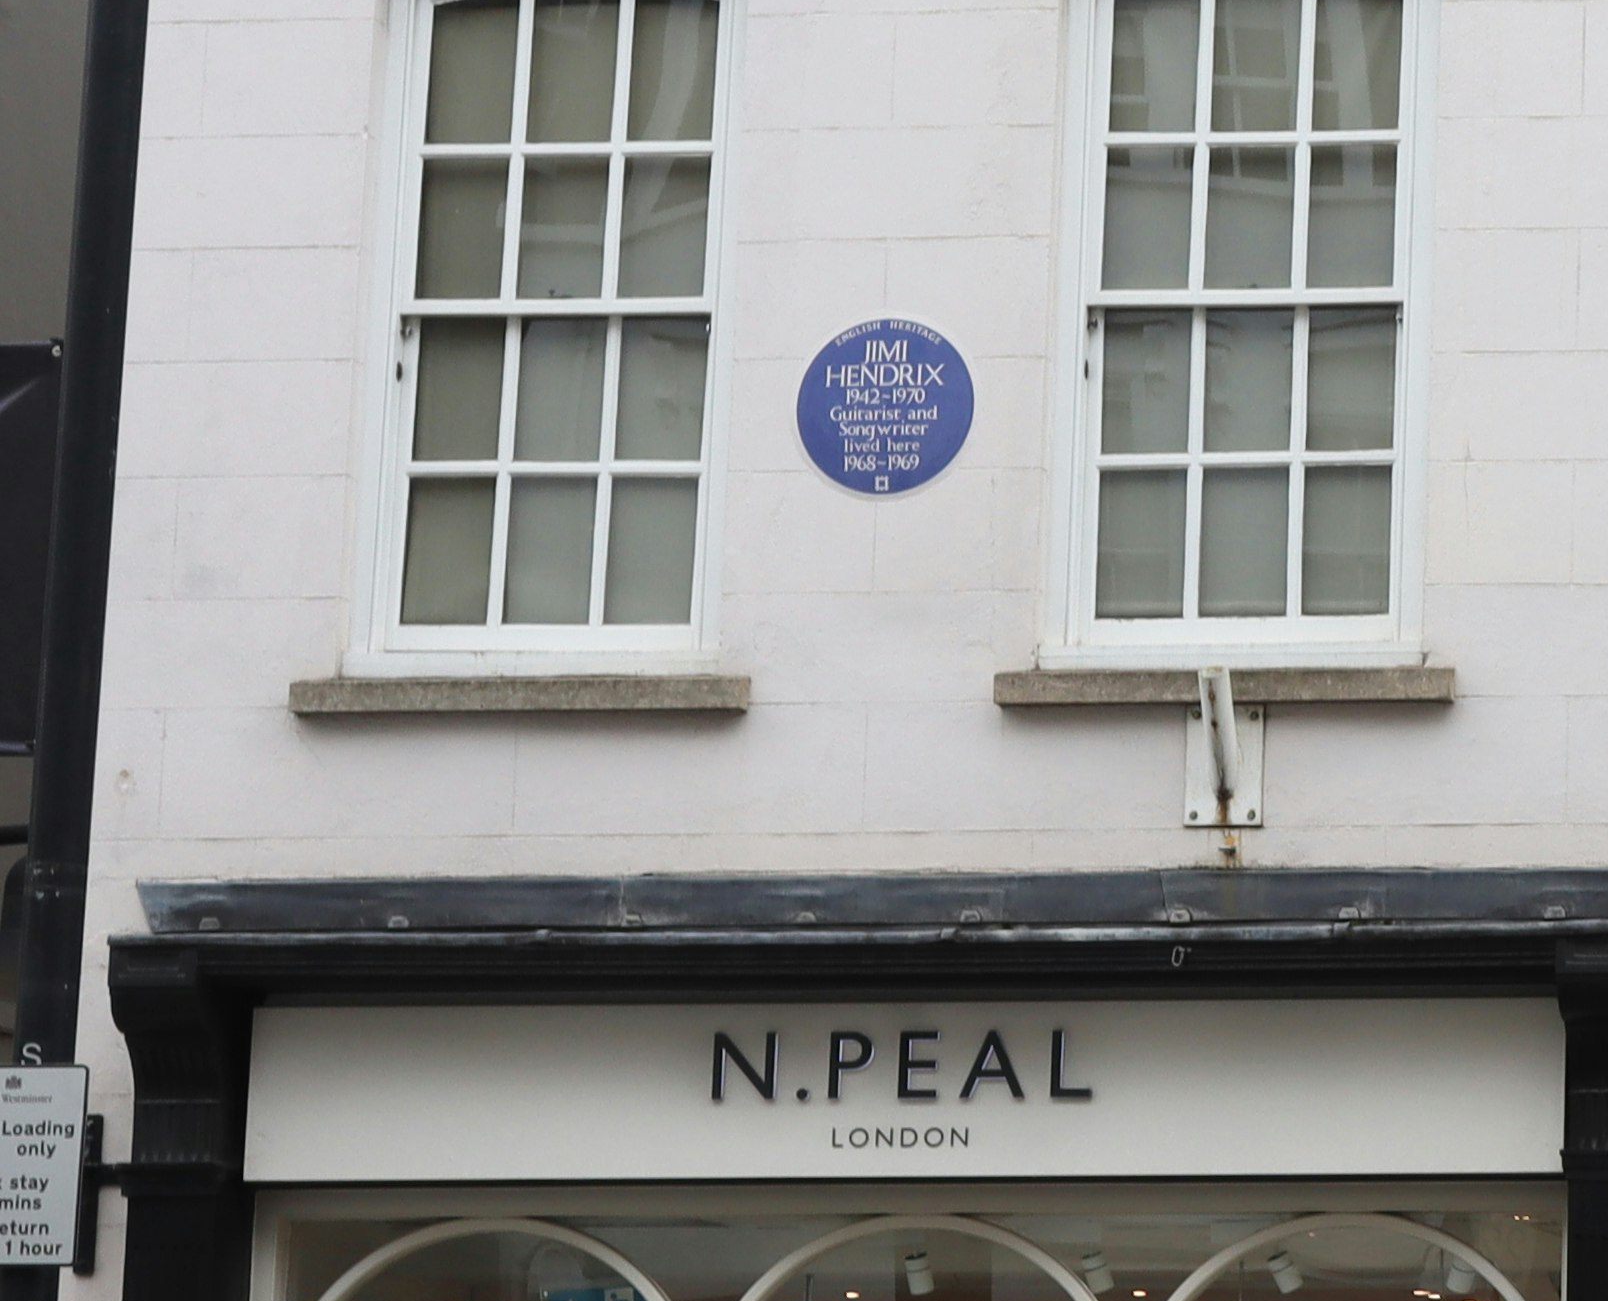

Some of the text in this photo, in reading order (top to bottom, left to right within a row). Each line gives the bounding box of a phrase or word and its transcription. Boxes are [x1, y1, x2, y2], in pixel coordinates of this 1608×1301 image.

[835, 321, 942, 347] ENGLISH HERITAGE
[864, 340, 908, 363] JIMI
[825, 363, 945, 388] HENDRIX
[829, 405, 938, 422] Guitarist and
[838, 422, 929, 441] Songwriter
[844, 438, 920, 452] lived here
[711, 1029, 1094, 1100] N.PEAL
[2, 1120, 75, 1139] Loading
[831, 1126, 970, 1148] LONDON
[17, 1140, 56, 1159] only
[10, 1174, 49, 1193] stay
[0, 1194, 41, 1210] mins
[0, 1220, 49, 1235] eturn
[5, 1240, 63, 1256] 1 hour
